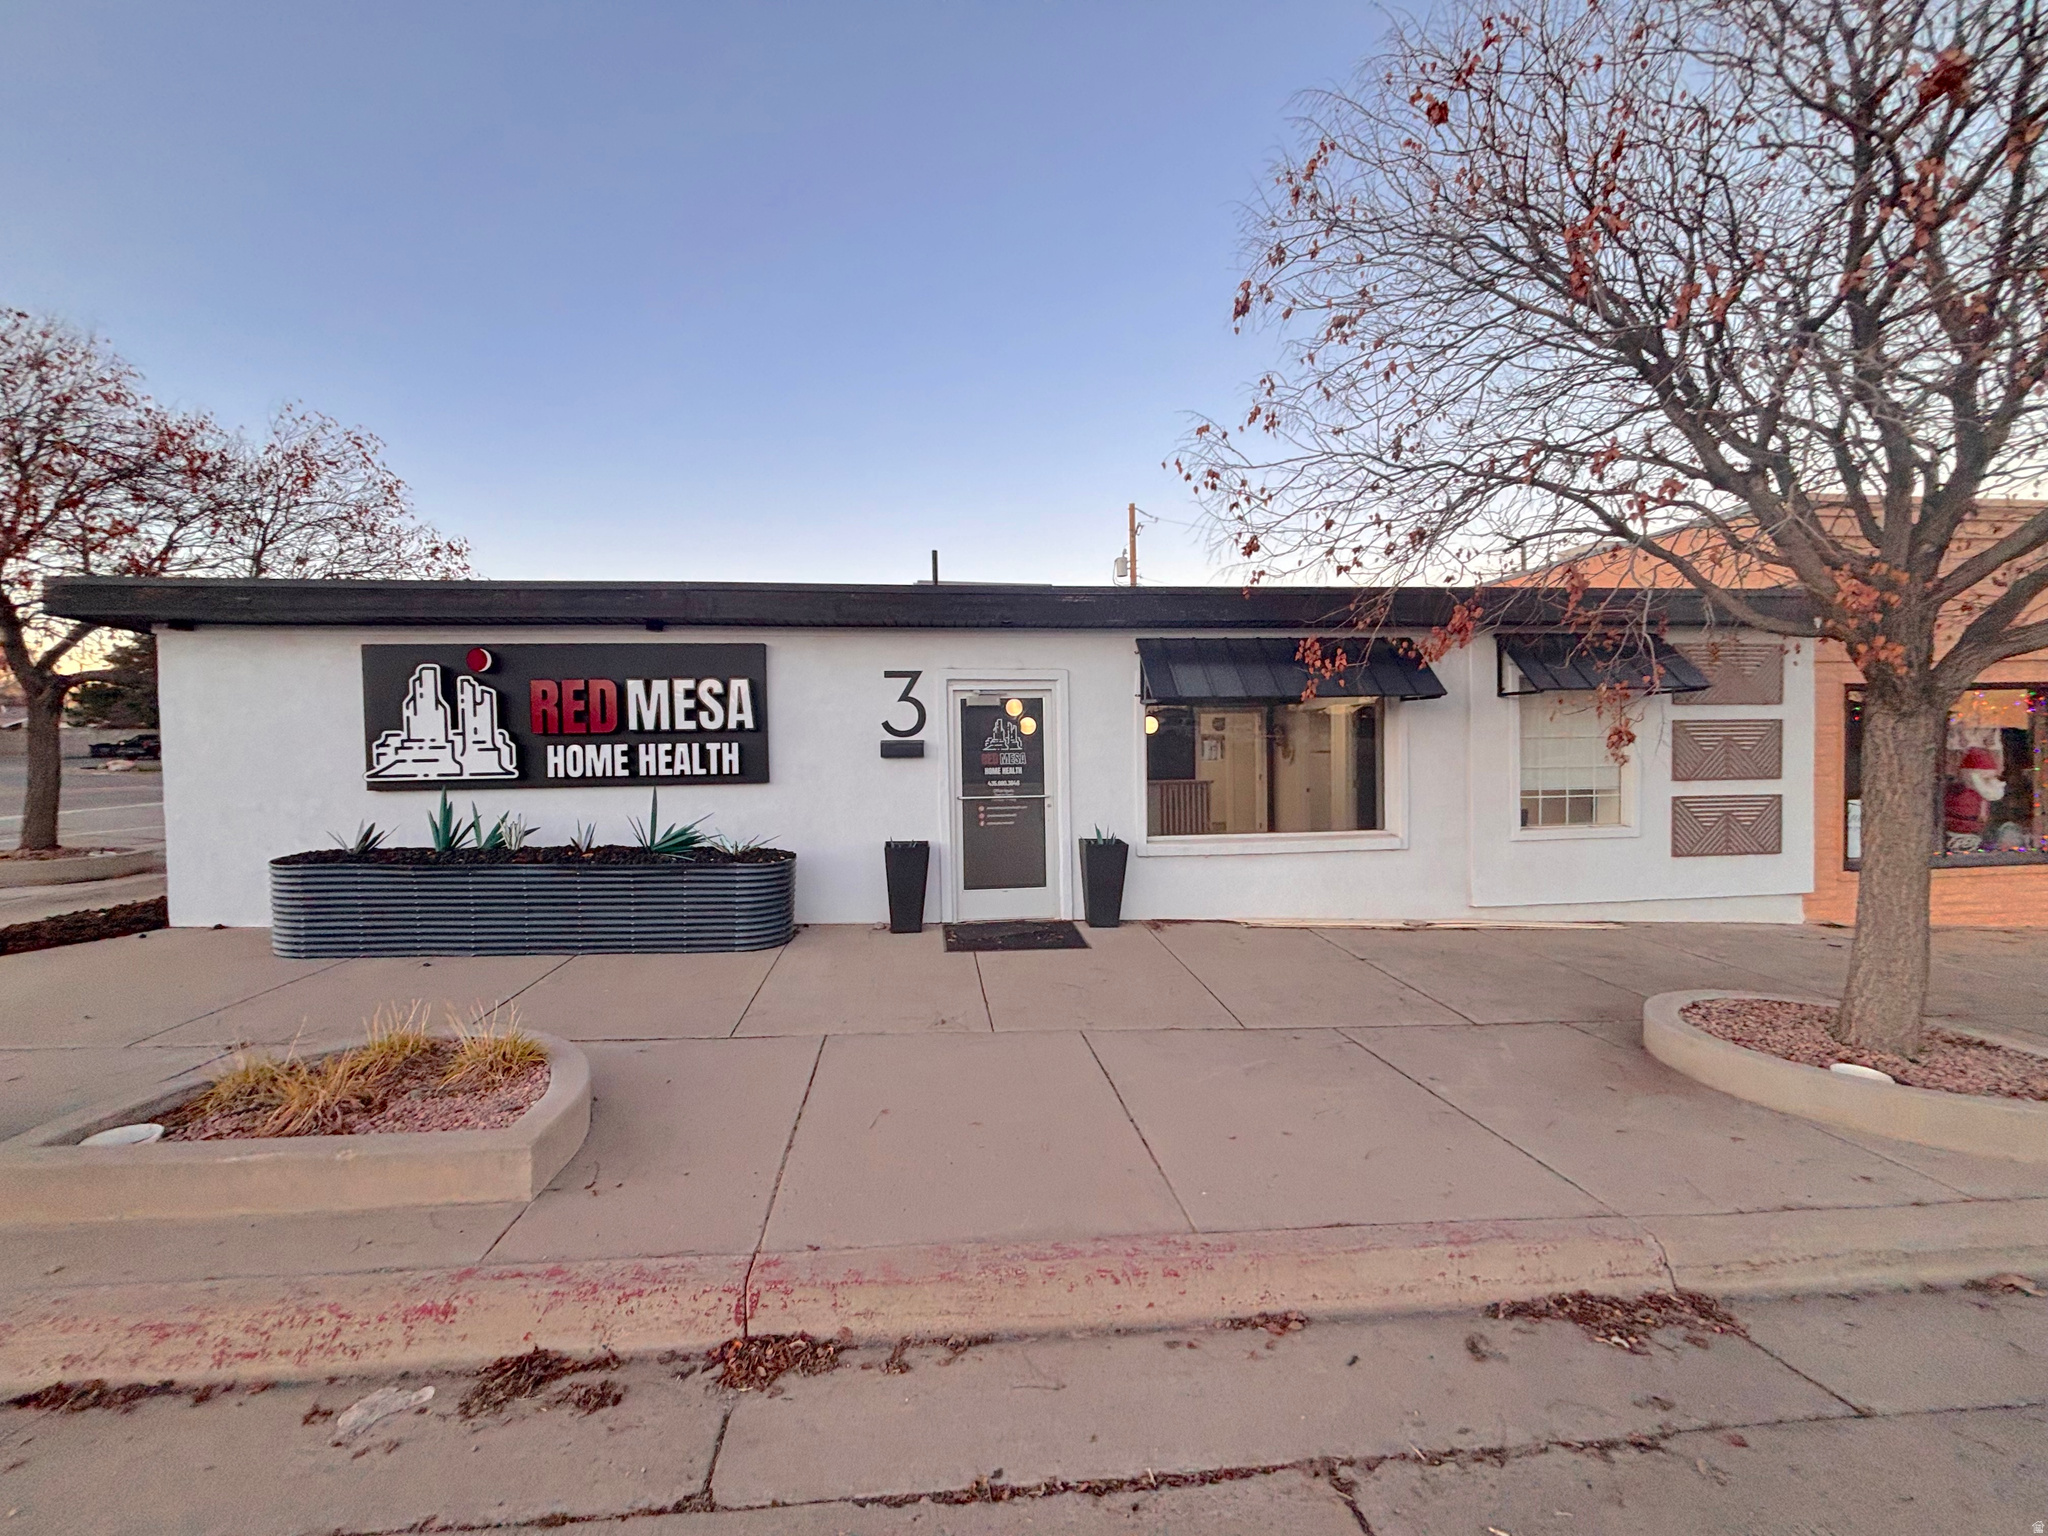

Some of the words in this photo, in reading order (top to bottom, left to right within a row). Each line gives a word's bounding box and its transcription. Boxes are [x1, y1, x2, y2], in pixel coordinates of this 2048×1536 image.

[530, 679, 617, 734] RED
[625, 677, 755, 731] MESA
[881, 670, 927, 738] 3
[547, 744, 629, 778] HOME
[638, 742, 740, 776] HEALTH
[1000, 752, 1026, 764] MESA
[1002, 766, 1022, 774] HEALTH
